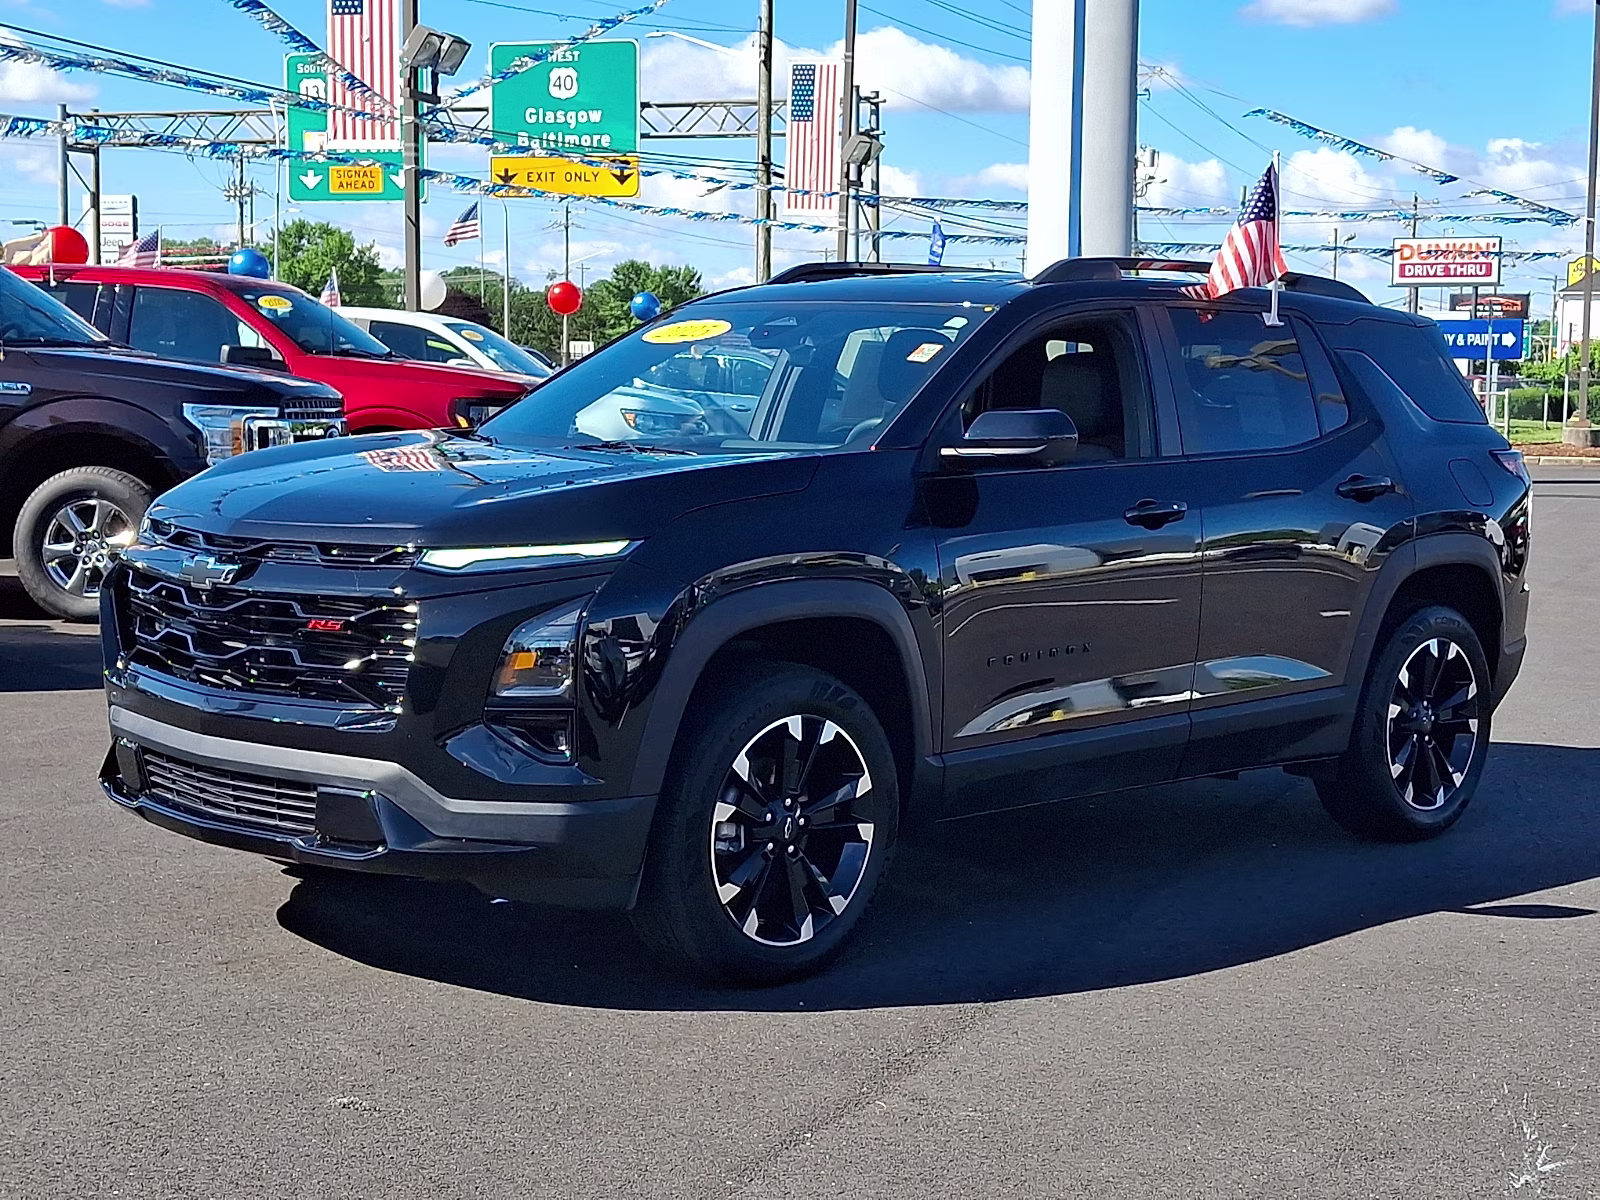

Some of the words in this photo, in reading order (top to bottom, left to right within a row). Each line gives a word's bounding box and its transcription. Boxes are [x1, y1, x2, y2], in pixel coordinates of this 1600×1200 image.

[552, 74, 574, 91] 40
[525, 107, 602, 129] Glasgow
[517, 131, 612, 148] Baltimore
[336, 169, 376, 179] SIGNAL
[526, 171, 556, 183] EXIT
[564, 171, 600, 183] ONLY
[337, 180, 375, 189] AHEAD
[1399, 242, 1497, 261] DUNKIN'
[1404, 264, 1445, 277] DRIVE
[1448, 263, 1486, 276] THRU
[1456, 333, 1465, 346] &
[308, 619, 343, 630] RS
[986, 642, 1092, 667] EQUINOX
